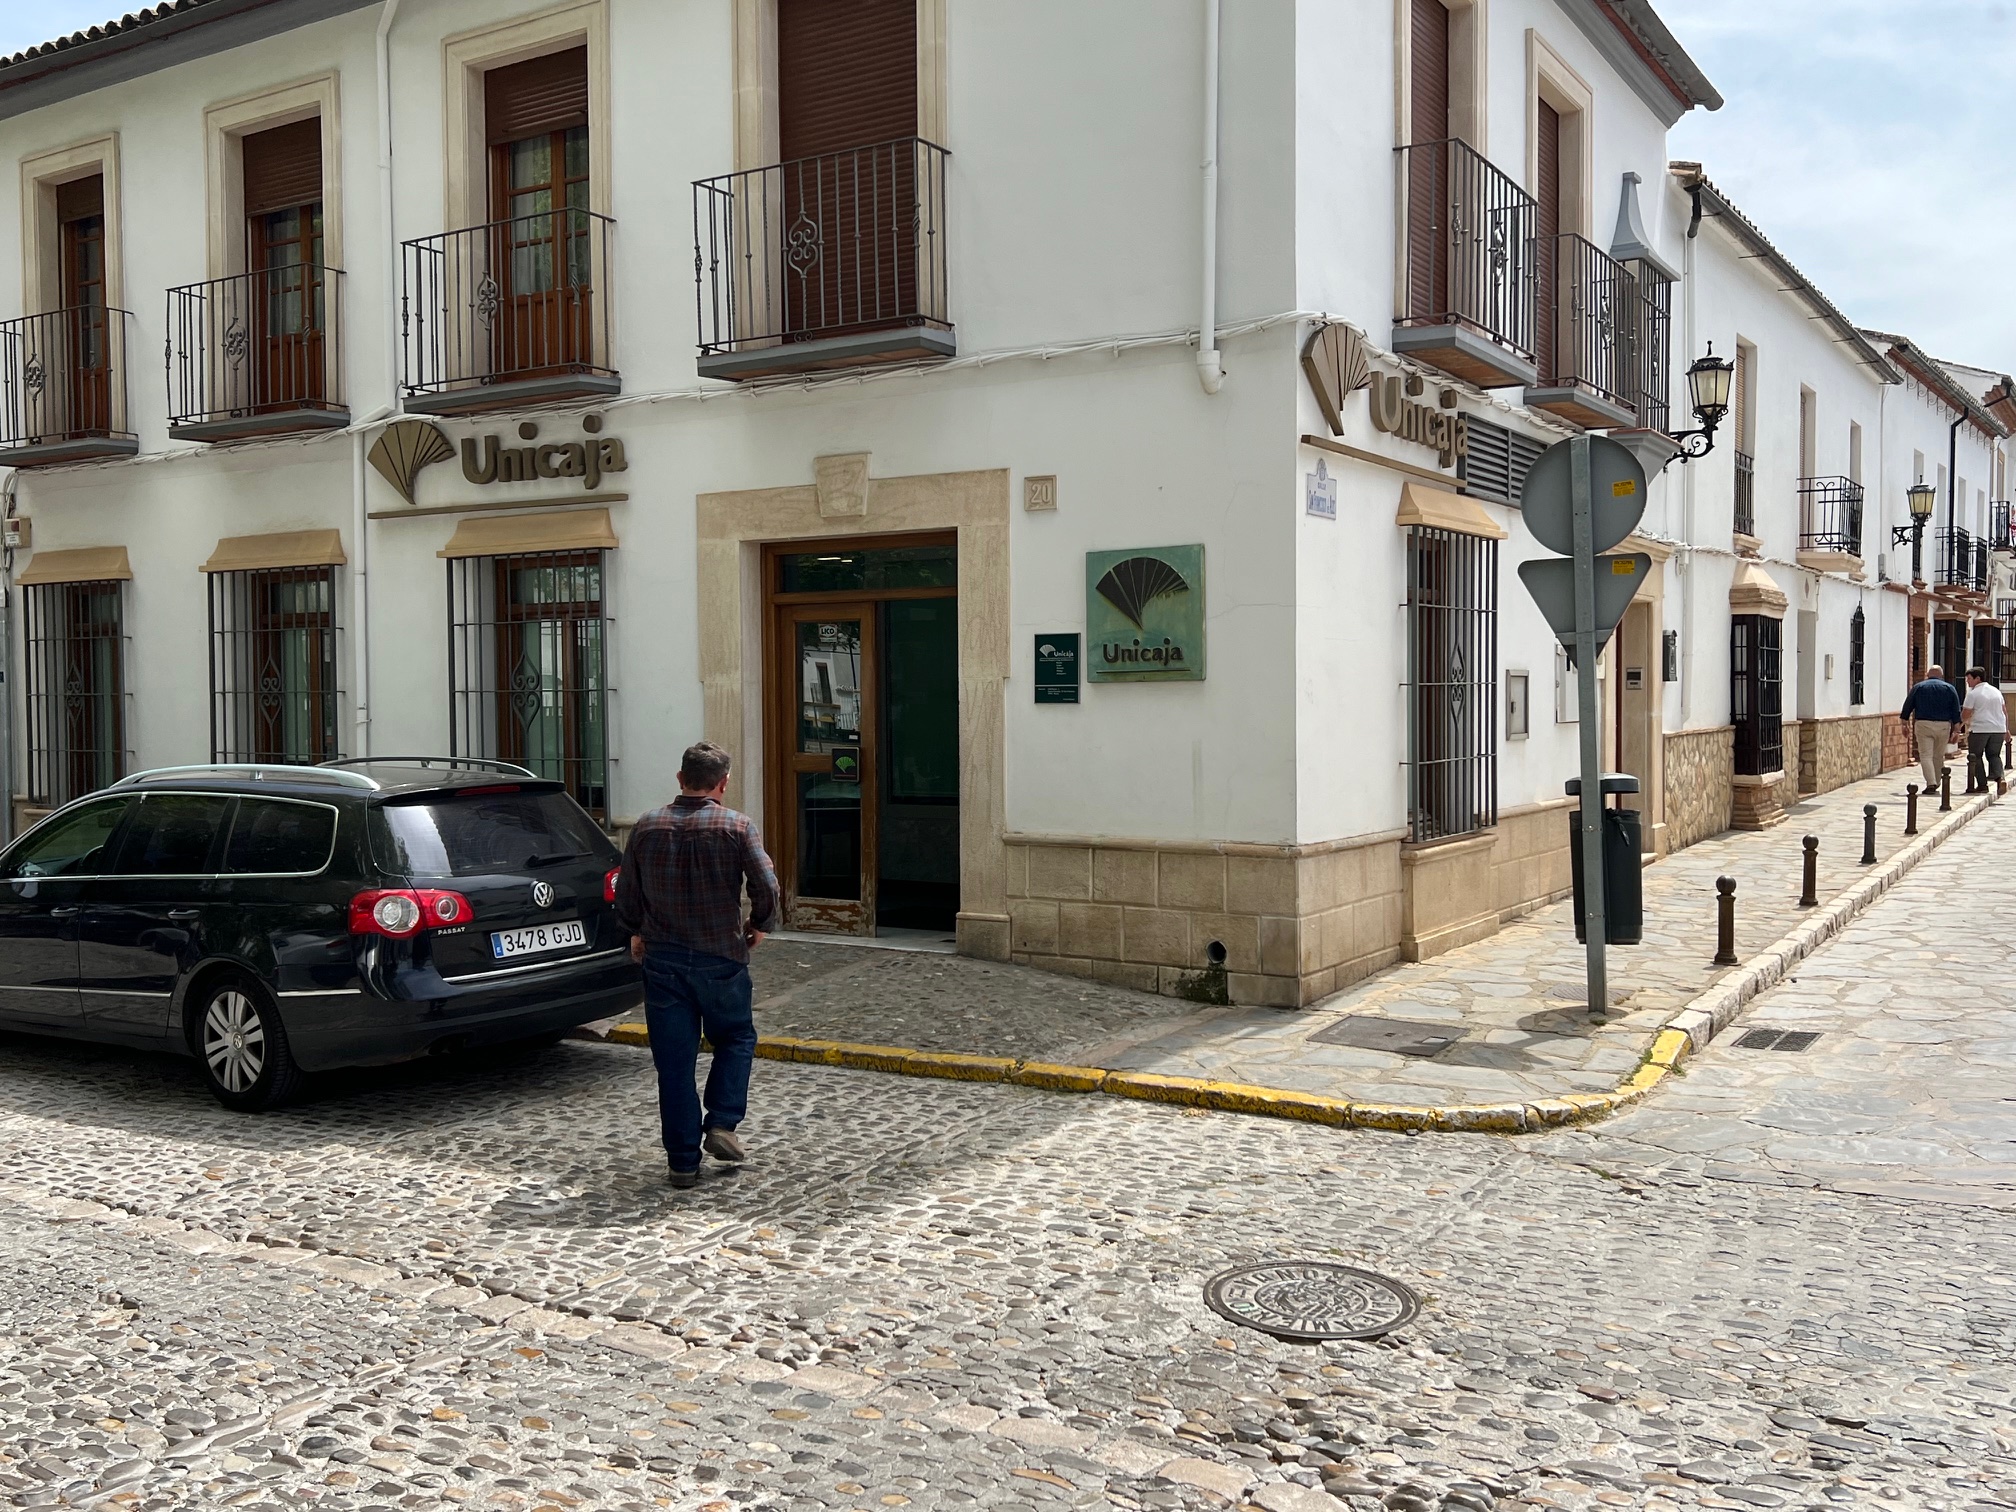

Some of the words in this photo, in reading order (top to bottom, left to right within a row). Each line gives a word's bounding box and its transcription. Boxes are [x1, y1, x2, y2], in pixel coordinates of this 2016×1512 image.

[1369, 371, 1468, 468] Unicaja
[461, 415, 628, 490] Unicaja
[1030, 483, 1052, 504] 20
[1053, 649, 1074, 658] Unicaja
[1103, 637, 1183, 666] Unicaja
[437, 926, 466, 936] PASSAT
[504, 929, 547, 952] 3478
[552, 924, 582, 944] GJD
